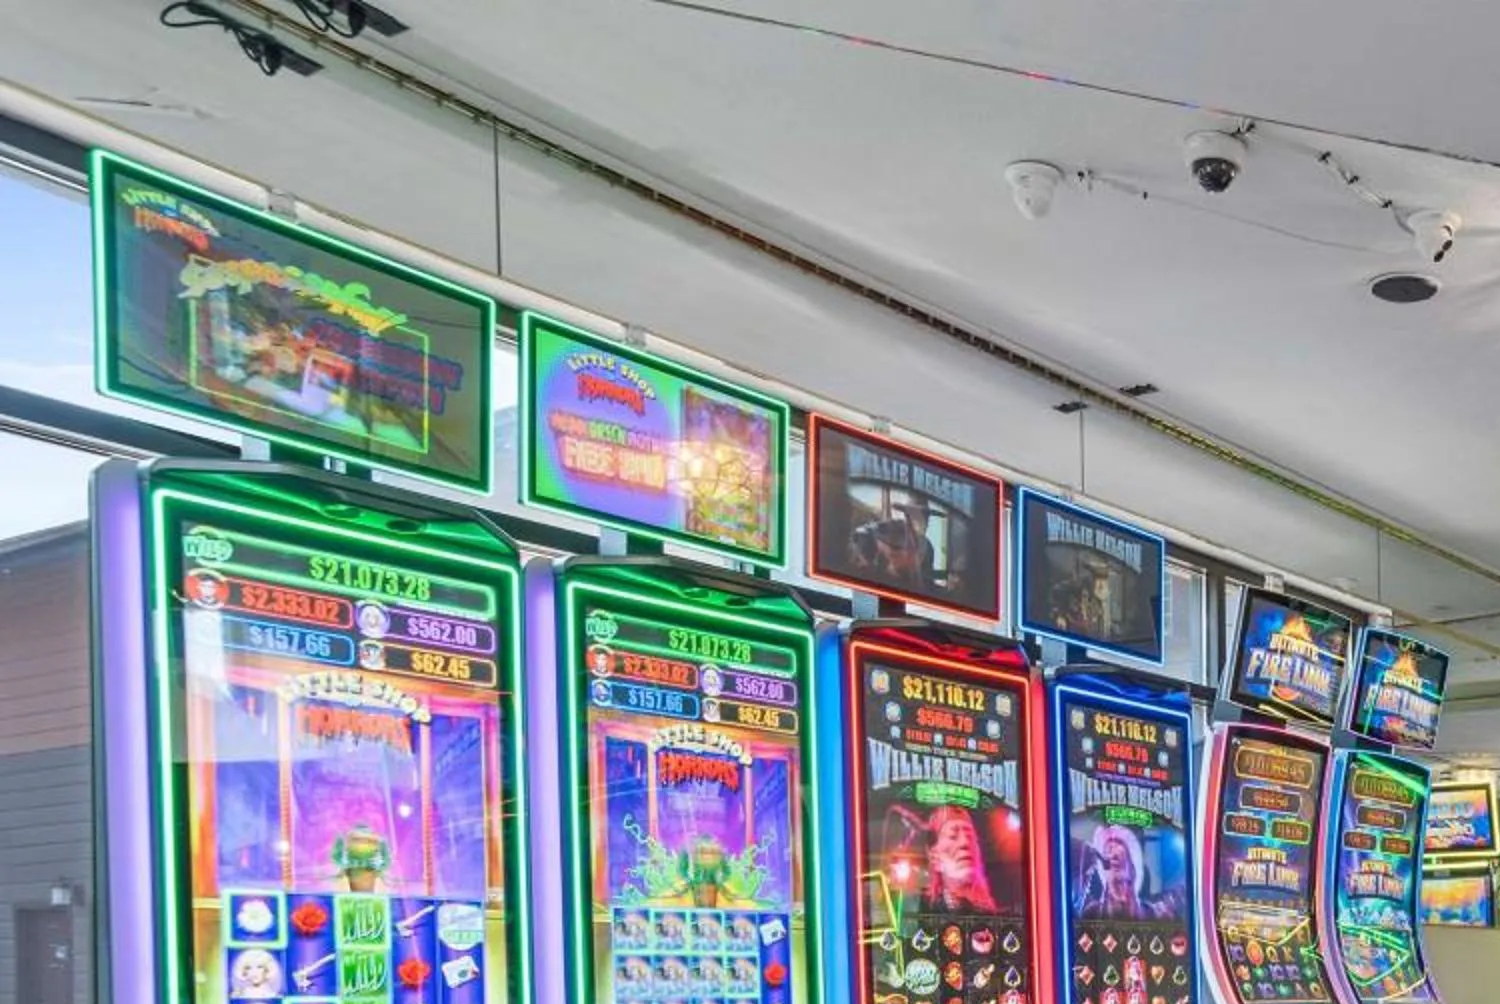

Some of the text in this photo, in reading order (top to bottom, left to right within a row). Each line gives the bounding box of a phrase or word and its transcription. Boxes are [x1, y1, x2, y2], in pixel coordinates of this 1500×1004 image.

[846, 443, 975, 518] WILLIE NELSON
[1046, 510, 1095, 547] WILLIE
[249, 625, 331, 657] $157.66
[407, 617, 477, 647] $562.00
[411, 651, 471, 680] $62.45
[867, 737, 945, 790] WILLIE
[947, 758, 1020, 809] NELSON
[1069, 767, 1127, 813] WILLIE
